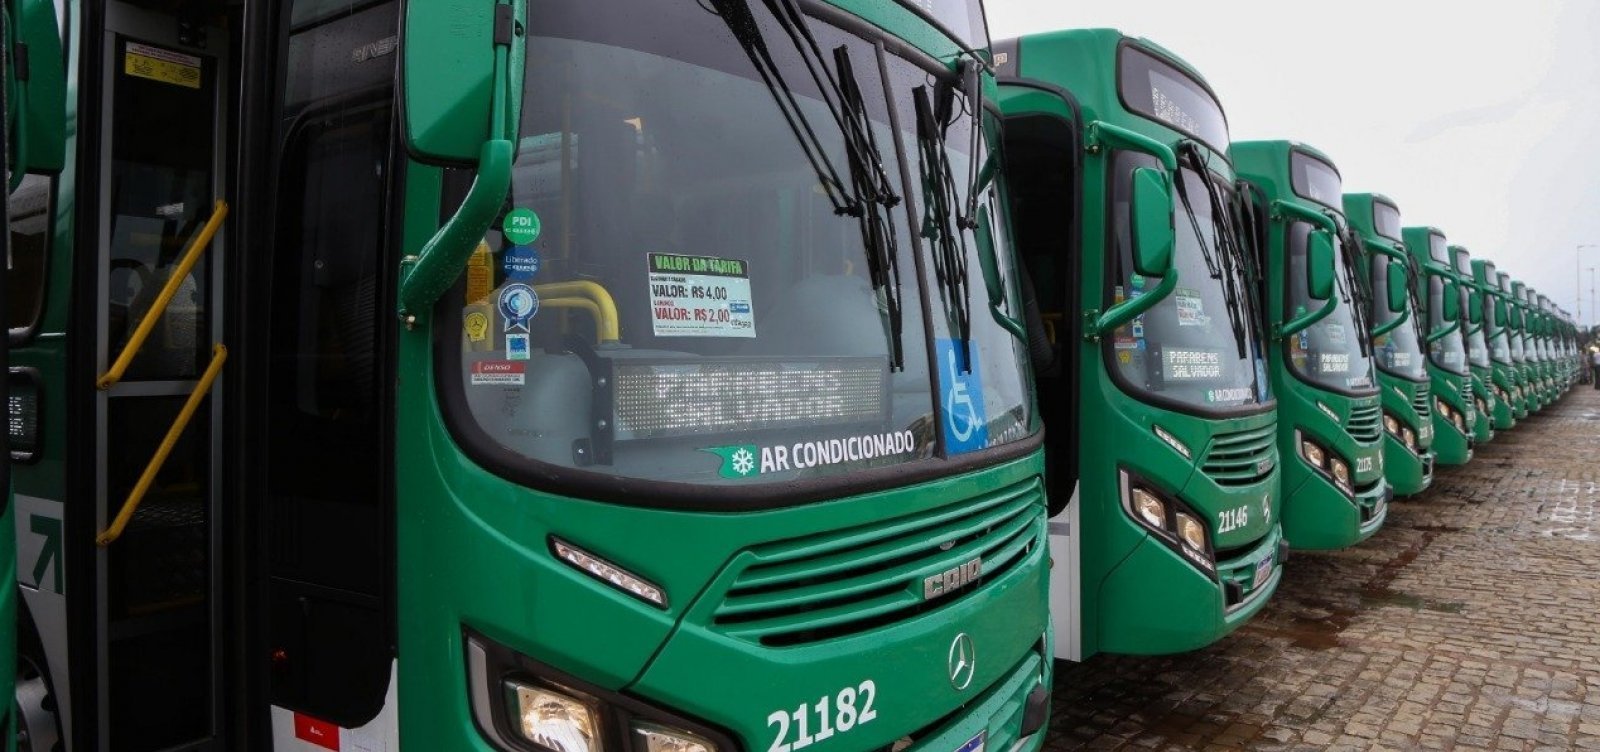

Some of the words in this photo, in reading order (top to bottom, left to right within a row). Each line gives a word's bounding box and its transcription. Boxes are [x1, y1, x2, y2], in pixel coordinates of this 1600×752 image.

[512, 216, 532, 227] PDI
[505, 255, 538, 264] Liberado
[654, 255, 691, 271] VALOR
[709, 258, 743, 275] TARIFA
[651, 284, 688, 299] VALOR:
[654, 307, 691, 321] VALOR:
[1169, 351, 1219, 364] PARABENS
[1172, 365, 1221, 378] SALVADOR
[655, 369, 843, 399] PARABENS
[664, 395, 845, 428] SALVADOR
[760, 444, 790, 474] AR
[792, 430, 915, 469] CONDICIONADO
[1217, 505, 1248, 534] 21146
[923, 556, 982, 601] CAIO
[767, 679, 877, 752] 21182
